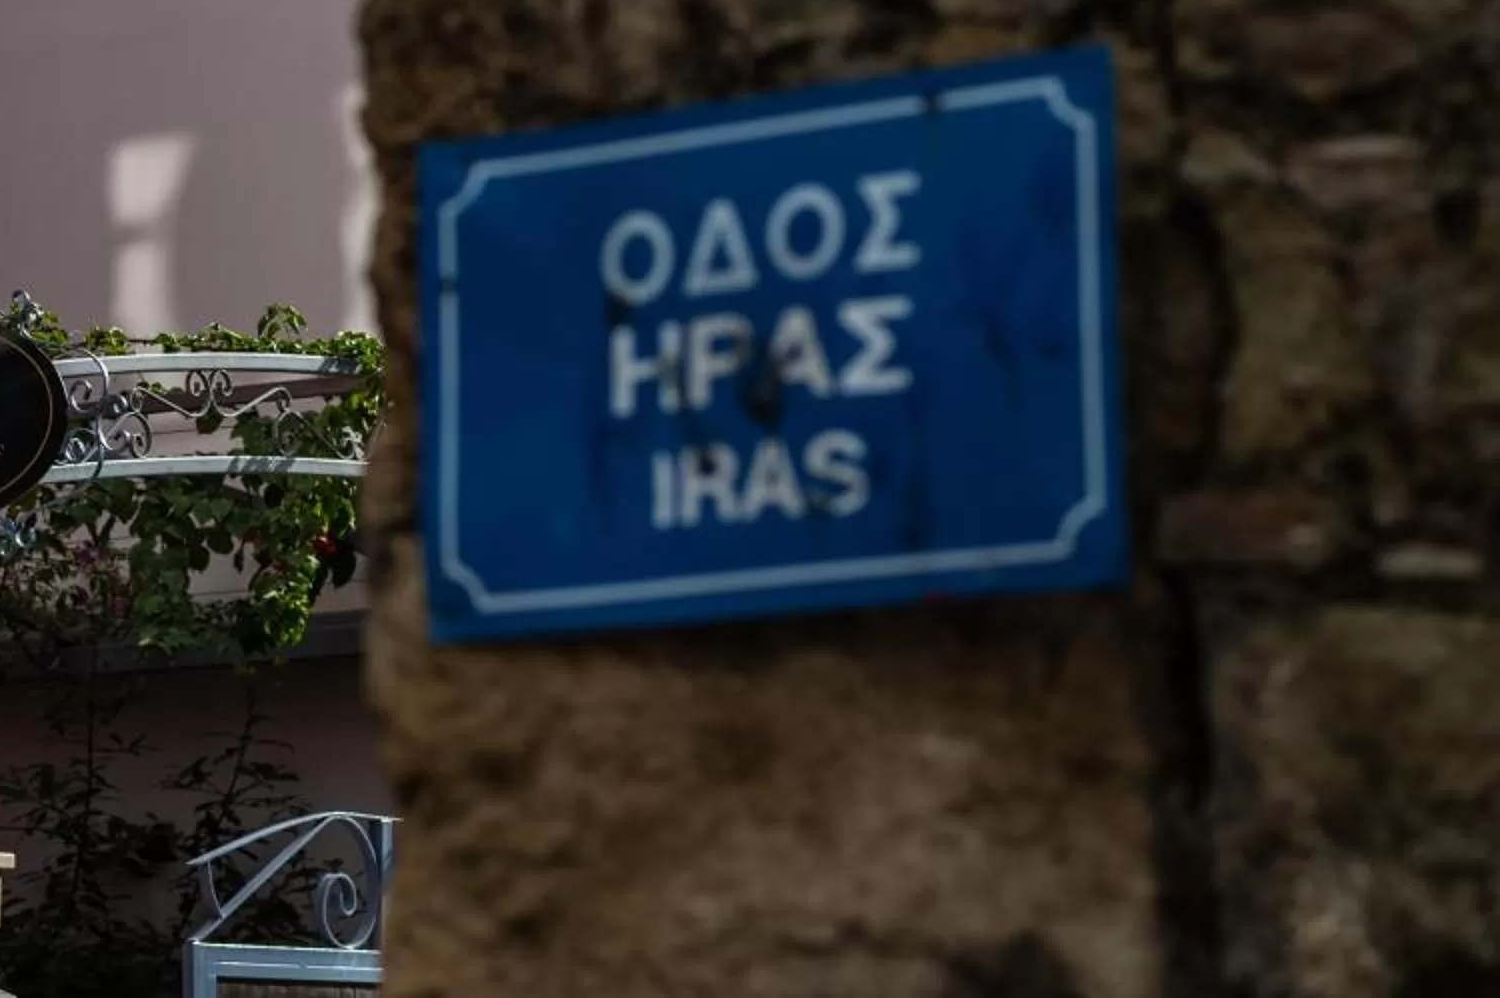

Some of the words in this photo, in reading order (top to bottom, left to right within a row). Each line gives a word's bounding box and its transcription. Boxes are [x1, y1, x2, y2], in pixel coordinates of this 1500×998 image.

[600, 168, 923, 307] ΟΔΟΣ
[608, 294, 917, 418] ΗΡΑΣ
[650, 426, 873, 531] IRAS
